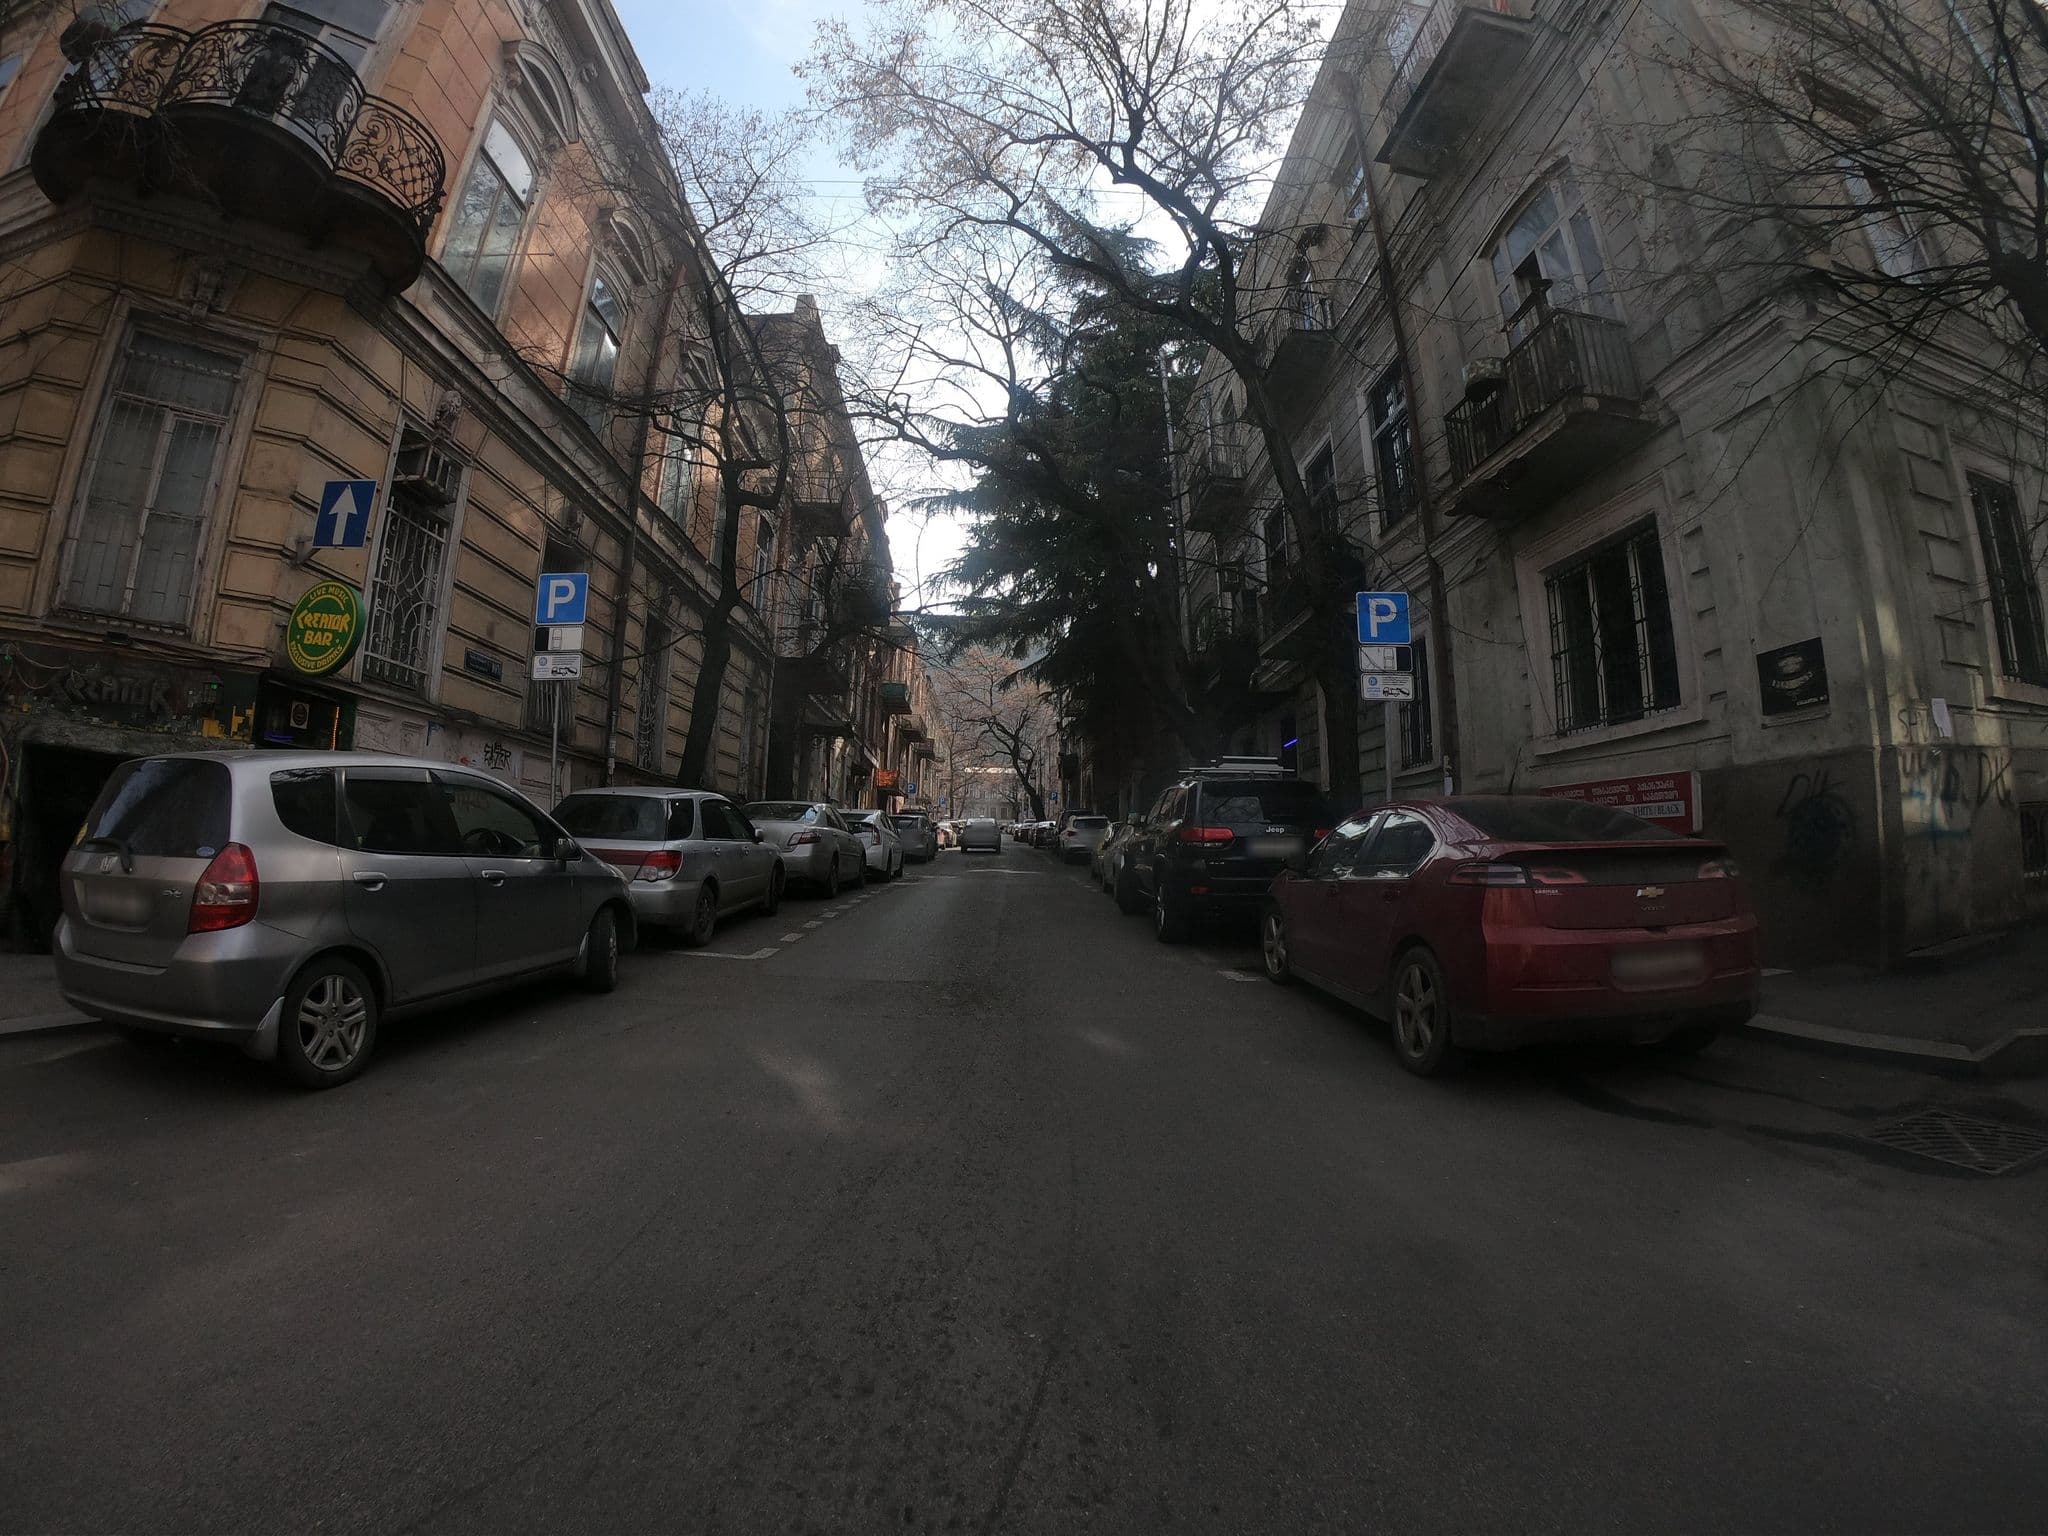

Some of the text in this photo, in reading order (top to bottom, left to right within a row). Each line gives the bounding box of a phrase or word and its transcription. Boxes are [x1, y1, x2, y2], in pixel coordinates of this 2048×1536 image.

[309, 585, 349, 604] LIVE MUSIC
[547, 579, 576, 619] P
[1368, 598, 1397, 638] P
[303, 630, 333, 646] BAR
[290, 640, 343, 669] EXCLUSIVE DRINKS
[1265, 826, 1285, 834] Jeep
